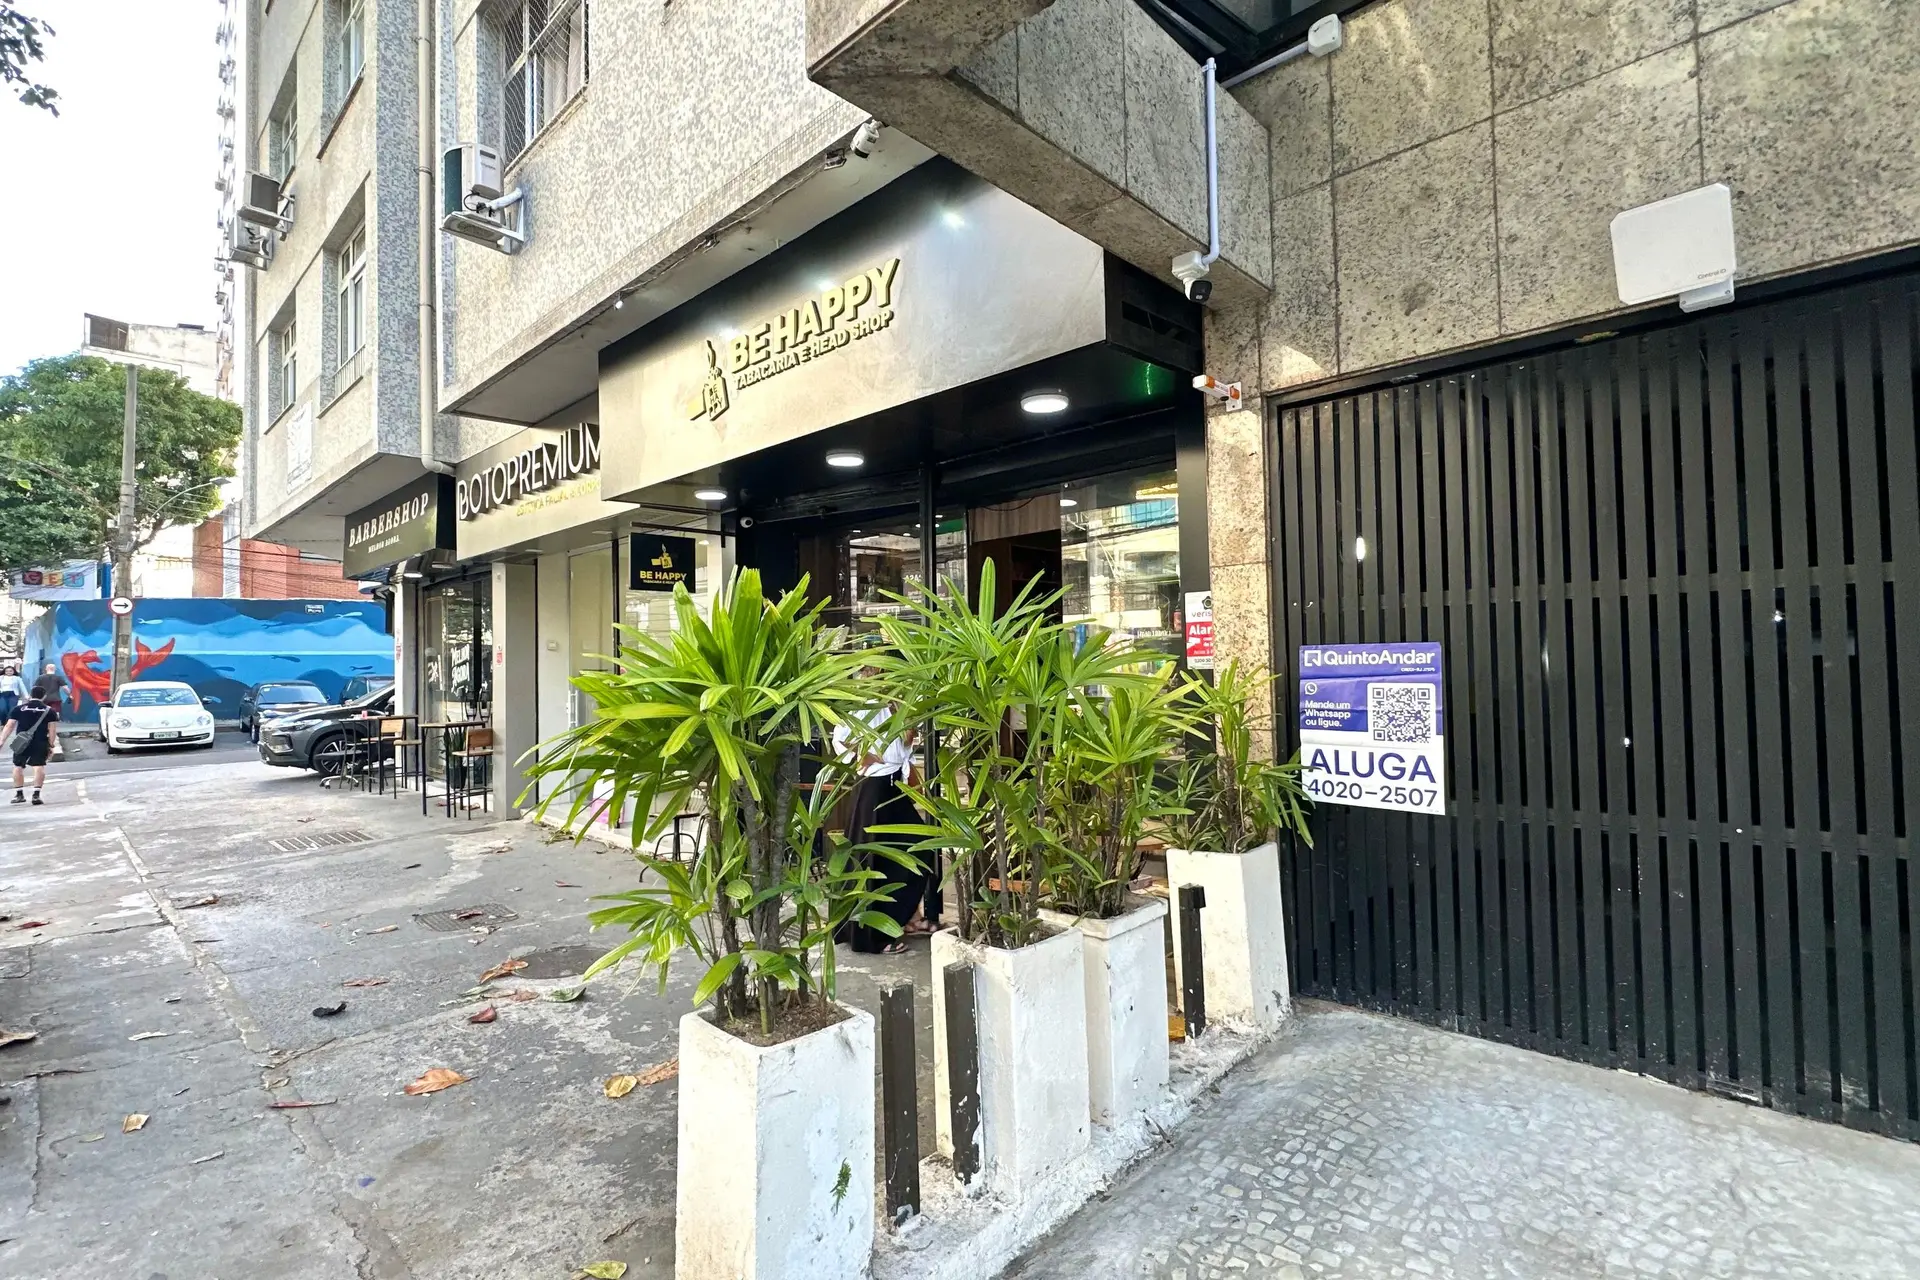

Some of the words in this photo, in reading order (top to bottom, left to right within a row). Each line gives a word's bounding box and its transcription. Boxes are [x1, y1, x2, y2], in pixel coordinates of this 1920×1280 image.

[732, 321, 770, 374] BE
[773, 258, 900, 354] HAPPY
[735, 353, 800, 390] TABACARIA
[801, 346, 811, 362] E
[813, 329, 850, 358] HEAD
[851, 310, 894, 340] SHOP
[456, 422, 600, 520] BOTOPREMIUM
[349, 492, 429, 548] BARBERSHOP
[640, 570, 653, 579] BE
[655, 571, 687, 580] HAPPY
[1323, 649, 1436, 666] QuintoAndar
[1305, 700, 1334, 709] Mande
[1305, 709, 1351, 720] Whatsapp
[1318, 718, 1343, 728] ligue.
[1308, 748, 1437, 784] ALUGA
[1308, 779, 1438, 807] 4020-2507
